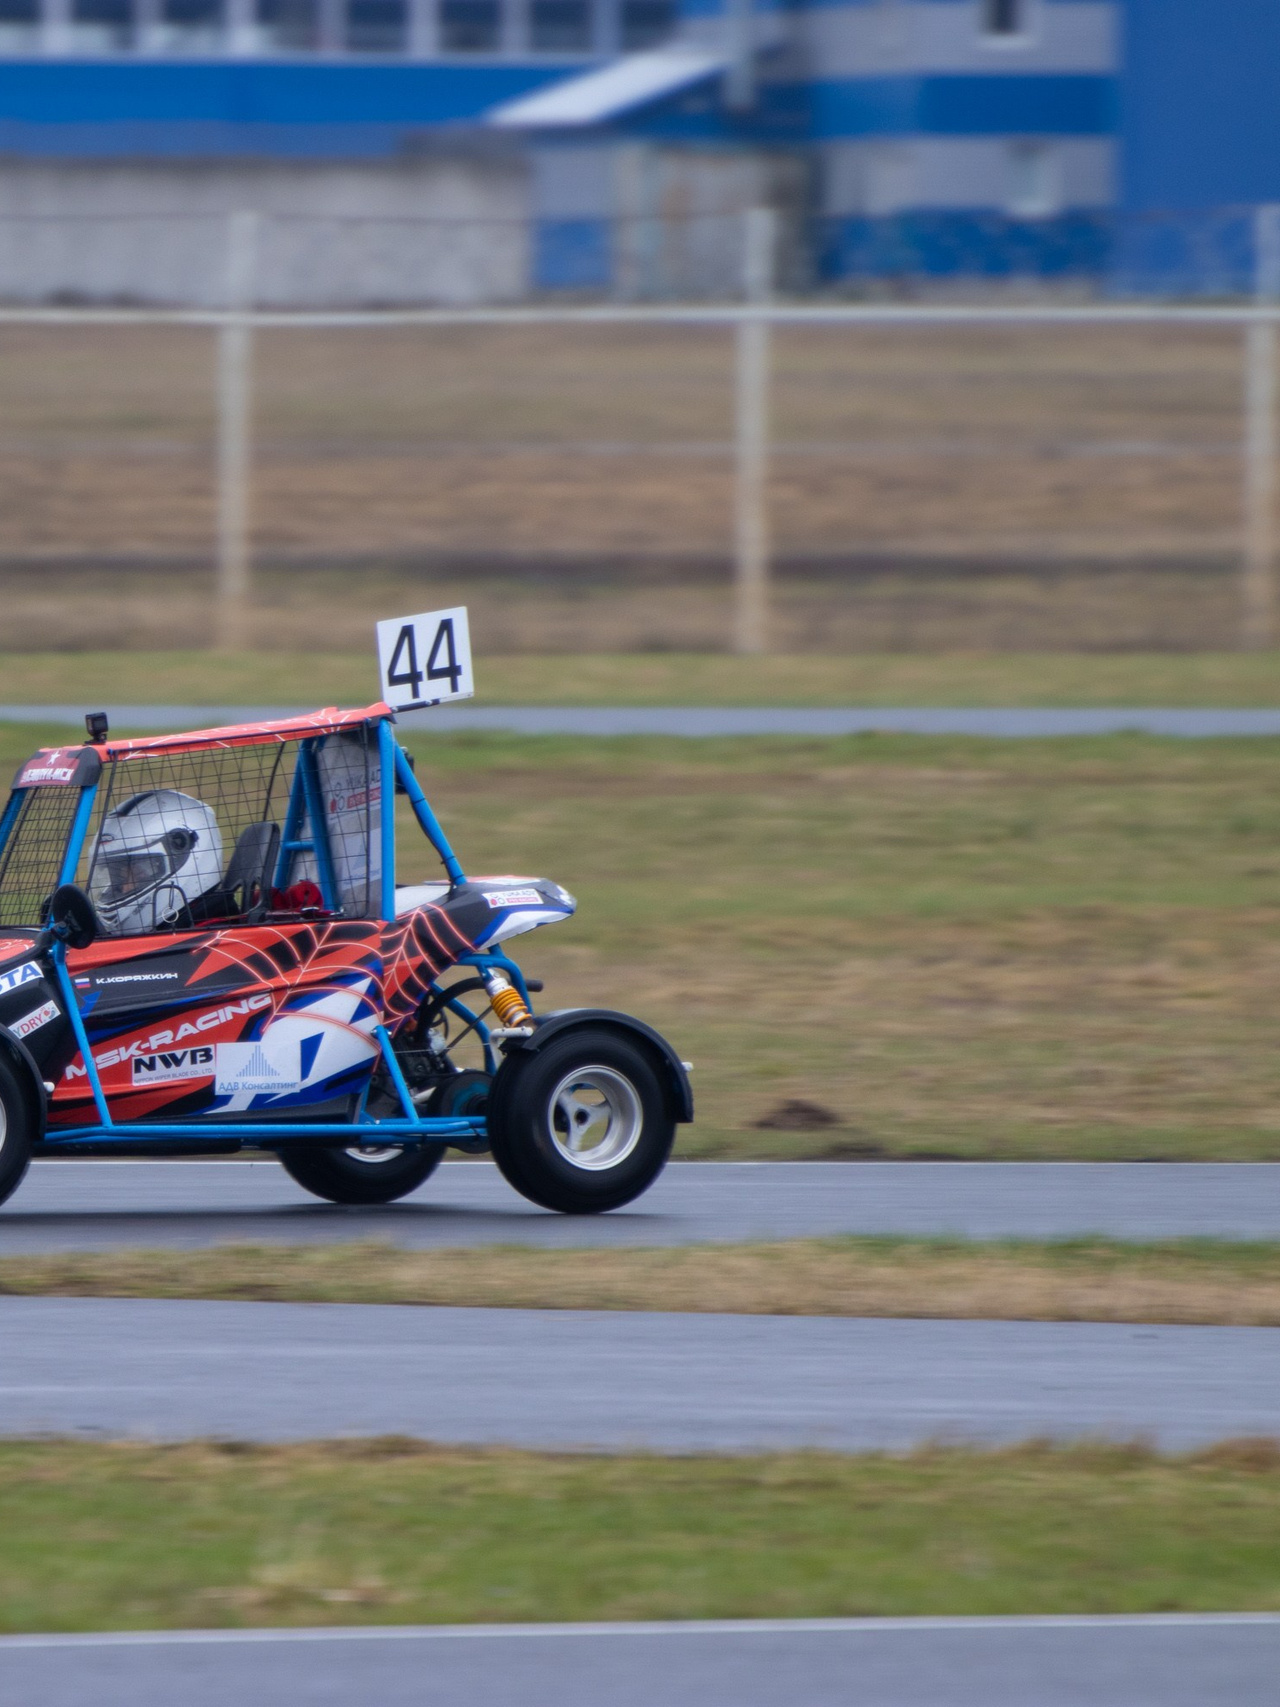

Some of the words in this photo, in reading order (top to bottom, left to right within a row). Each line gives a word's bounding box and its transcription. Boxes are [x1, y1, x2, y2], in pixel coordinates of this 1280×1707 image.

[387, 618, 462, 699] 44
[65, 993, 272, 1080] MSK-RACING
[134, 1047, 213, 1074] NWB
[172, 1071, 189, 1079] BLADE
[218, 1081, 239, 1092] АДВ
[241, 1081, 299, 1091] Консалтинг
